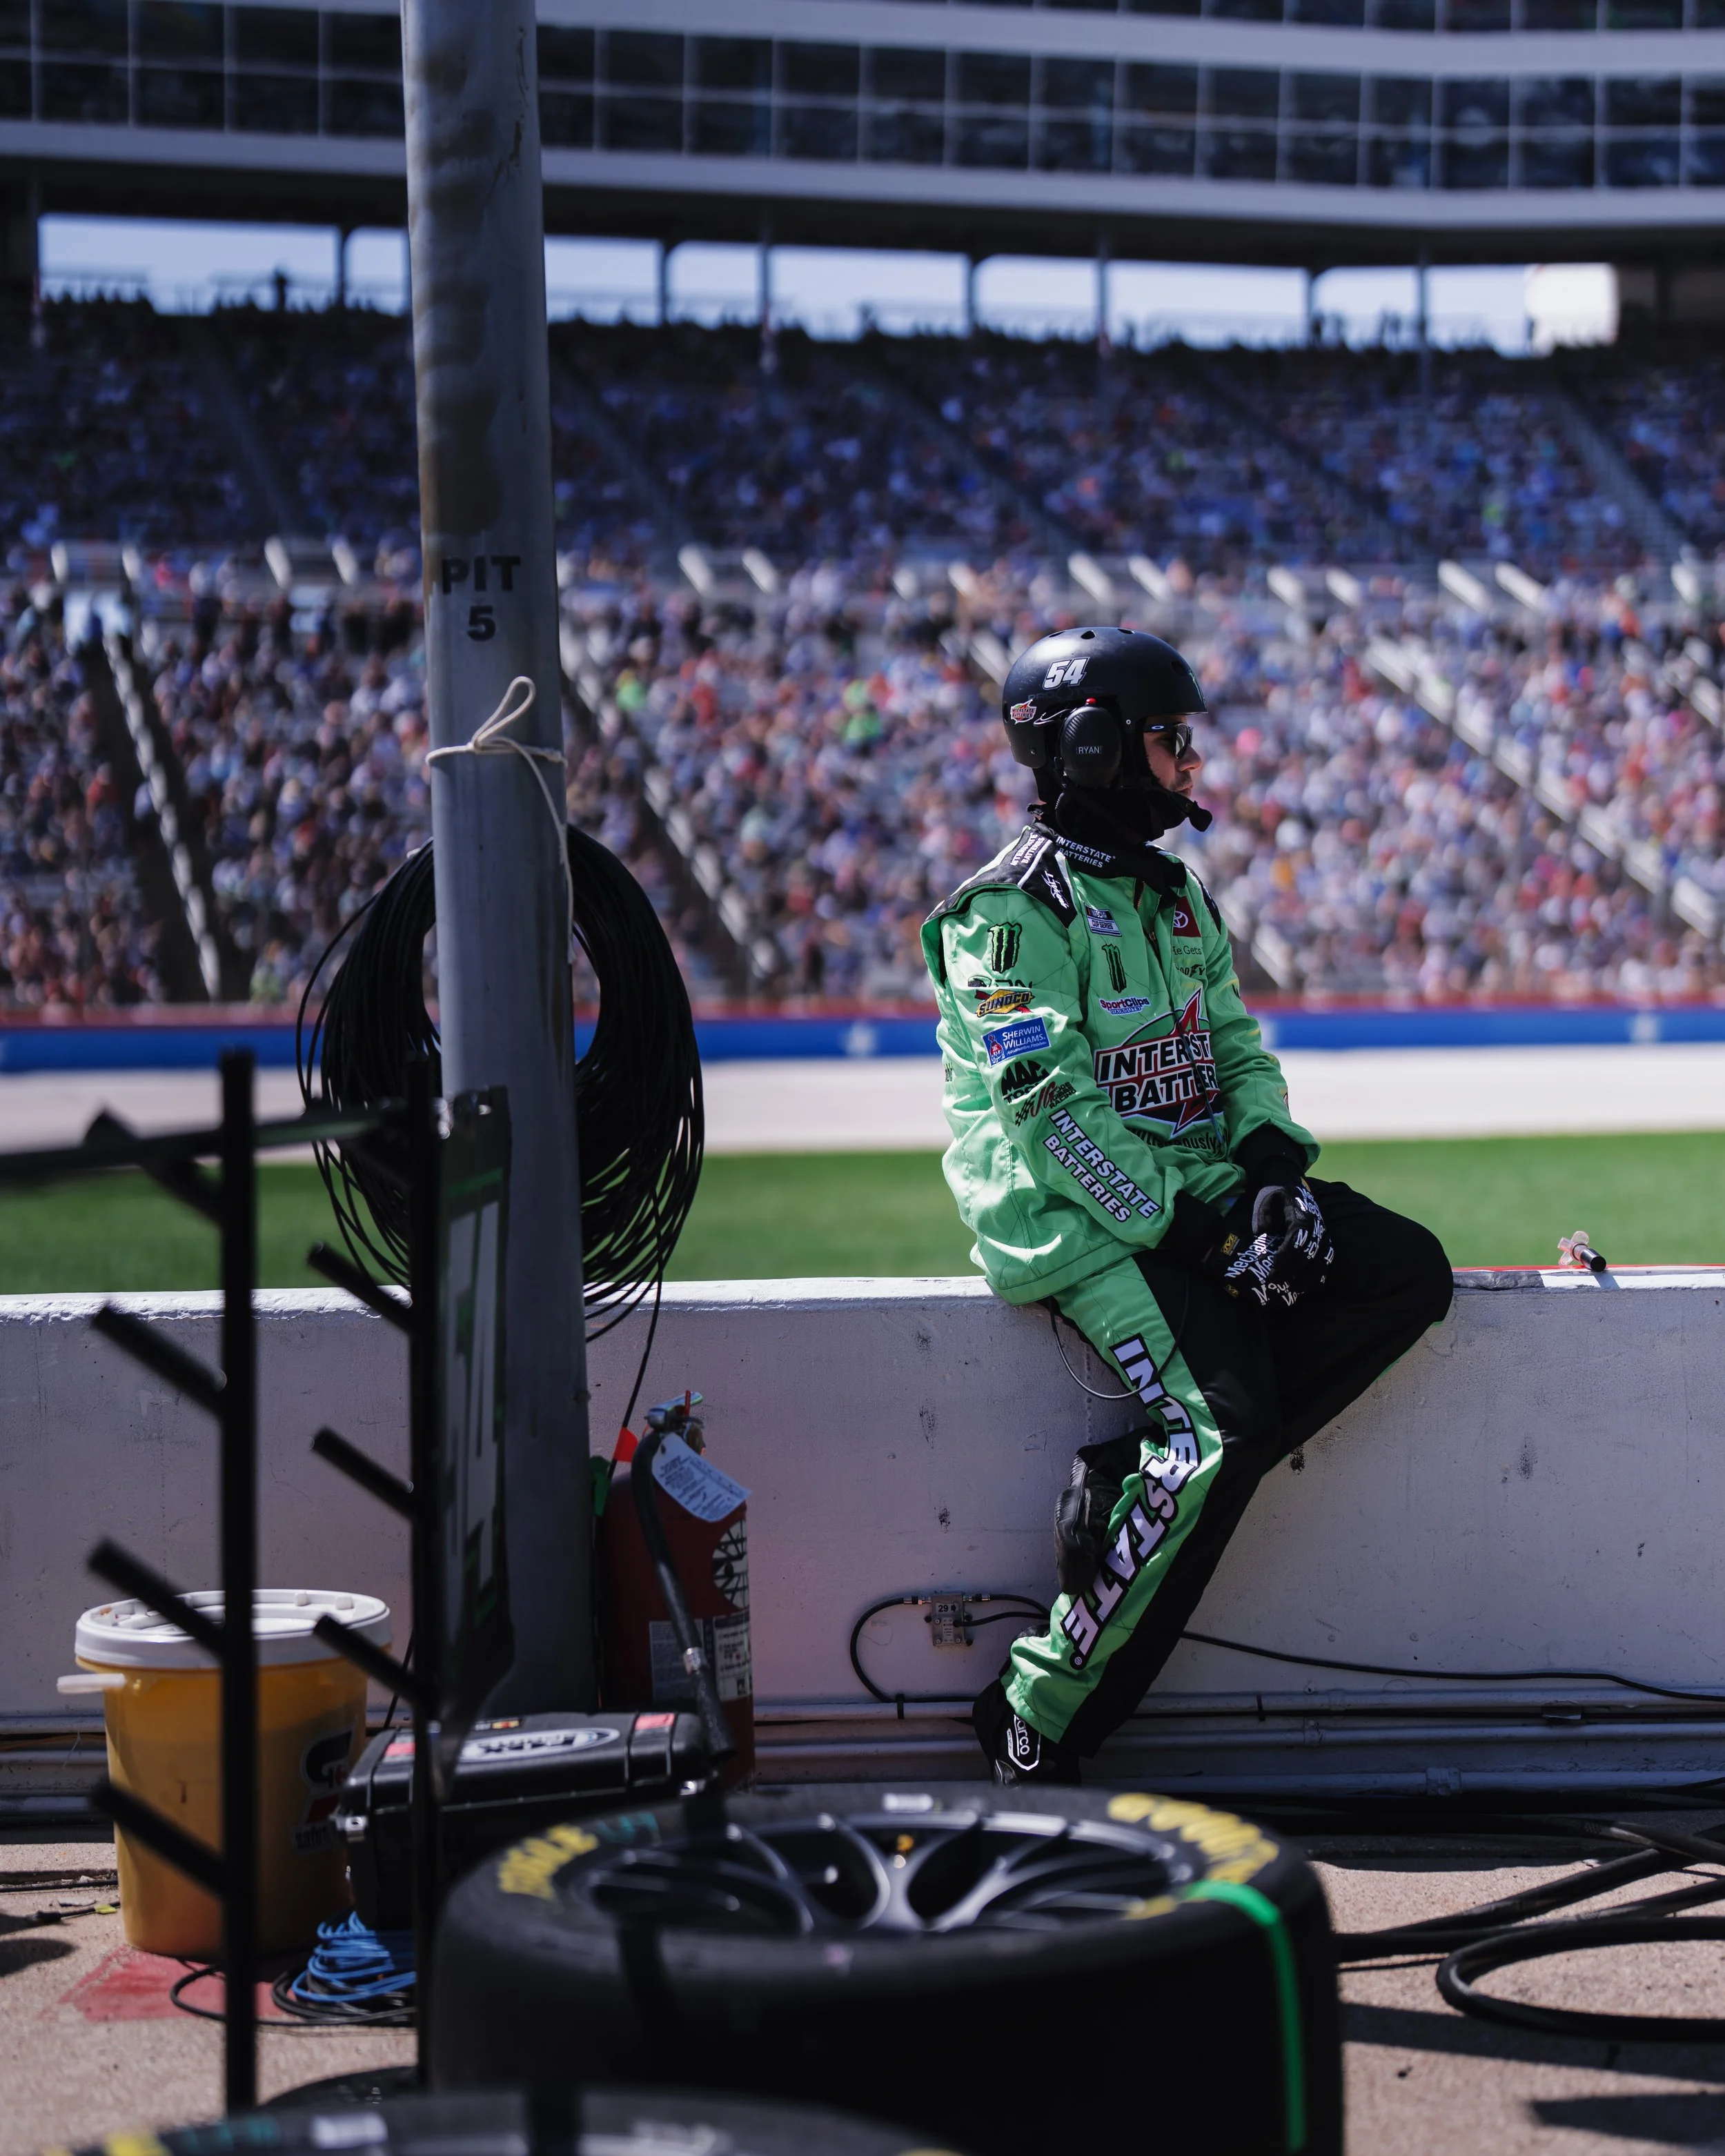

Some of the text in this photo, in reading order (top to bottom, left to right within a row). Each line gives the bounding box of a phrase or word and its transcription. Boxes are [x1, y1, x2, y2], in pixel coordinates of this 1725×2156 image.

[442, 555, 521, 595] PIT
[467, 604, 496, 642] 5
[1043, 657, 1089, 689] 54
[1078, 746, 1100, 754] RYAN
[1056, 835, 1112, 863] INTERSTATE
[1058, 847, 1103, 868] BATTERIES
[978, 992, 1031, 1015] SUNOCO
[1003, 1025, 1041, 1041] SHERWIN
[1099, 1034, 1210, 1082] INTERST
[1001, 1060, 1049, 1096] MAC
[1058, 1081, 1072, 1091] JOE
[1115, 1064, 1219, 1112] BATTER
[1049, 1089, 1077, 1109] RACING
[1043, 1133, 1132, 1223] BATTERIES
[1049, 1108, 1160, 1219] INTERSTATE
[1061, 1333, 1201, 1659] INTERSTATE
[938, 1604, 948, 1612] 29
[1016, 1717, 1030, 1755] arco
